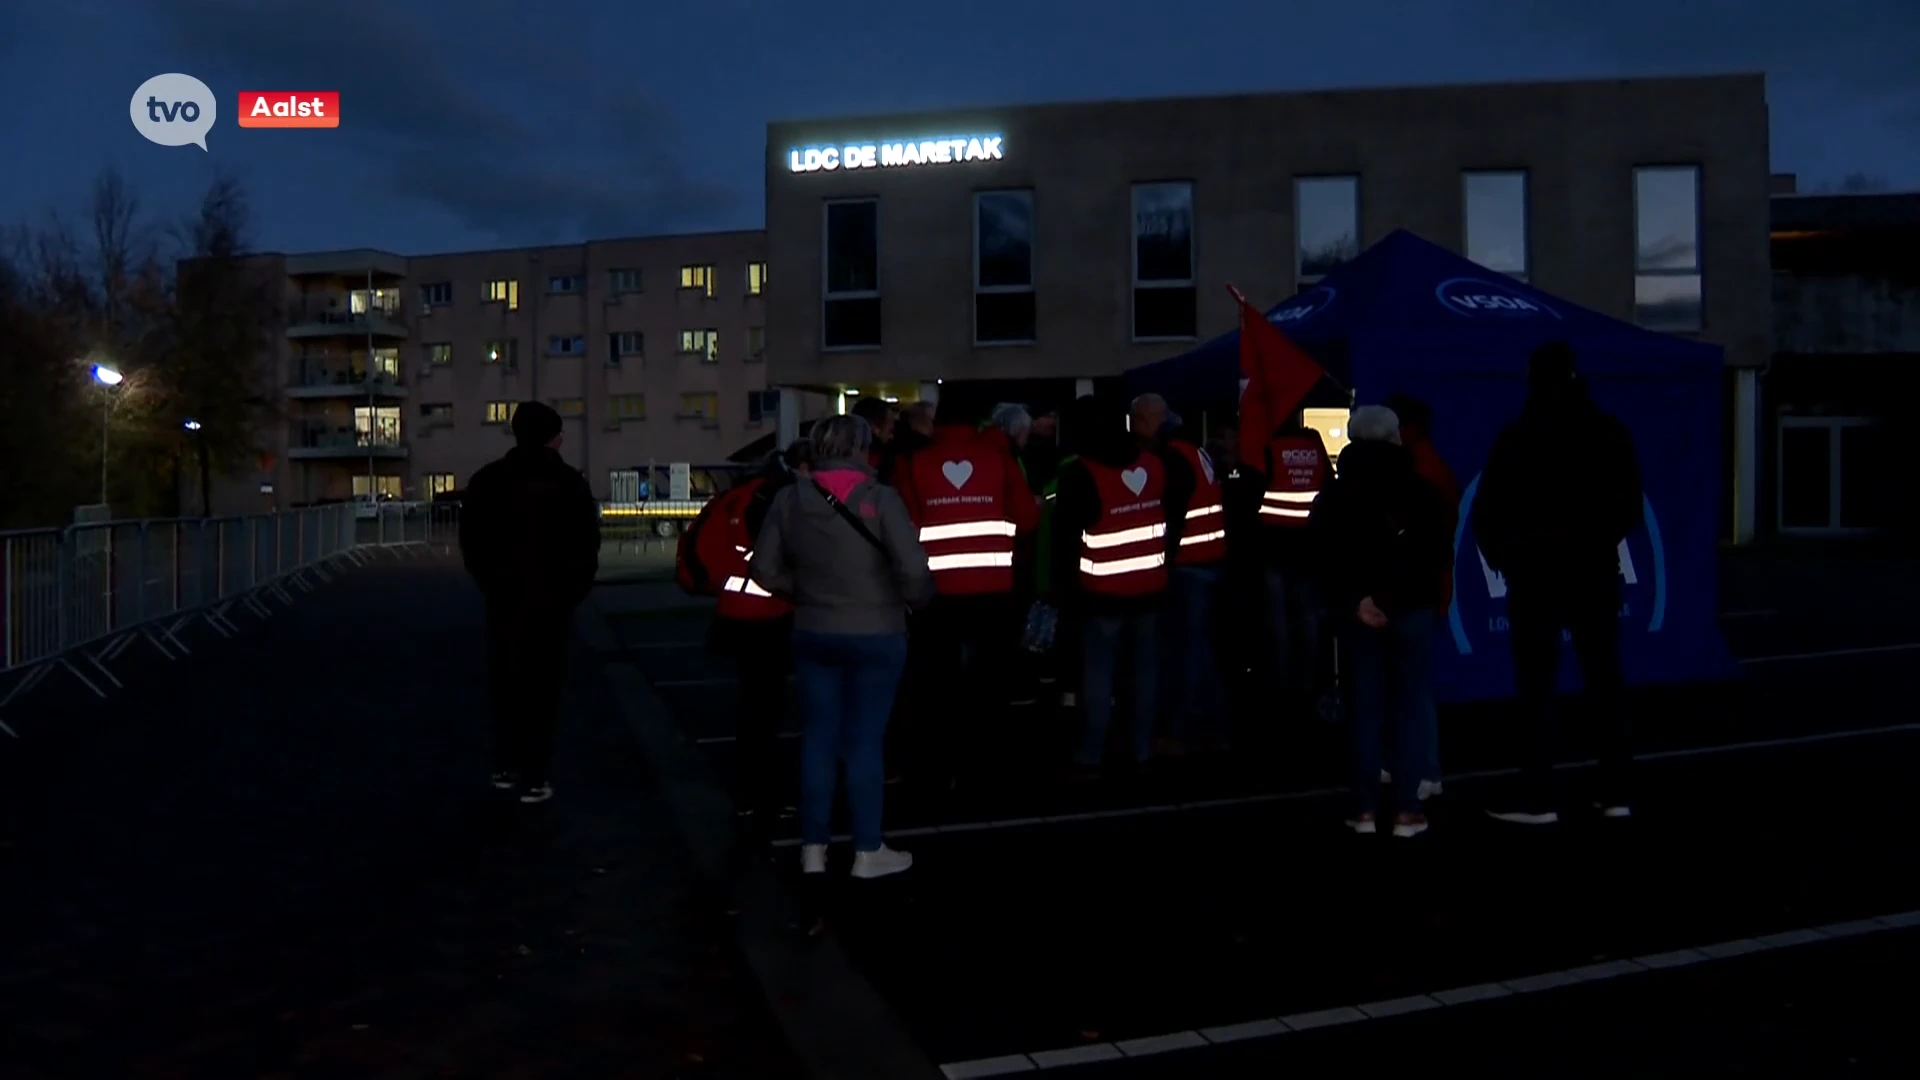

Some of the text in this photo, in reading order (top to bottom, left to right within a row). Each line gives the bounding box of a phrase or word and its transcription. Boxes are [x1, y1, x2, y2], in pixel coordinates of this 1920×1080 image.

[790, 137, 1002, 172] LDC DE MARETAK
[1449, 294, 1540, 312] VSOA
